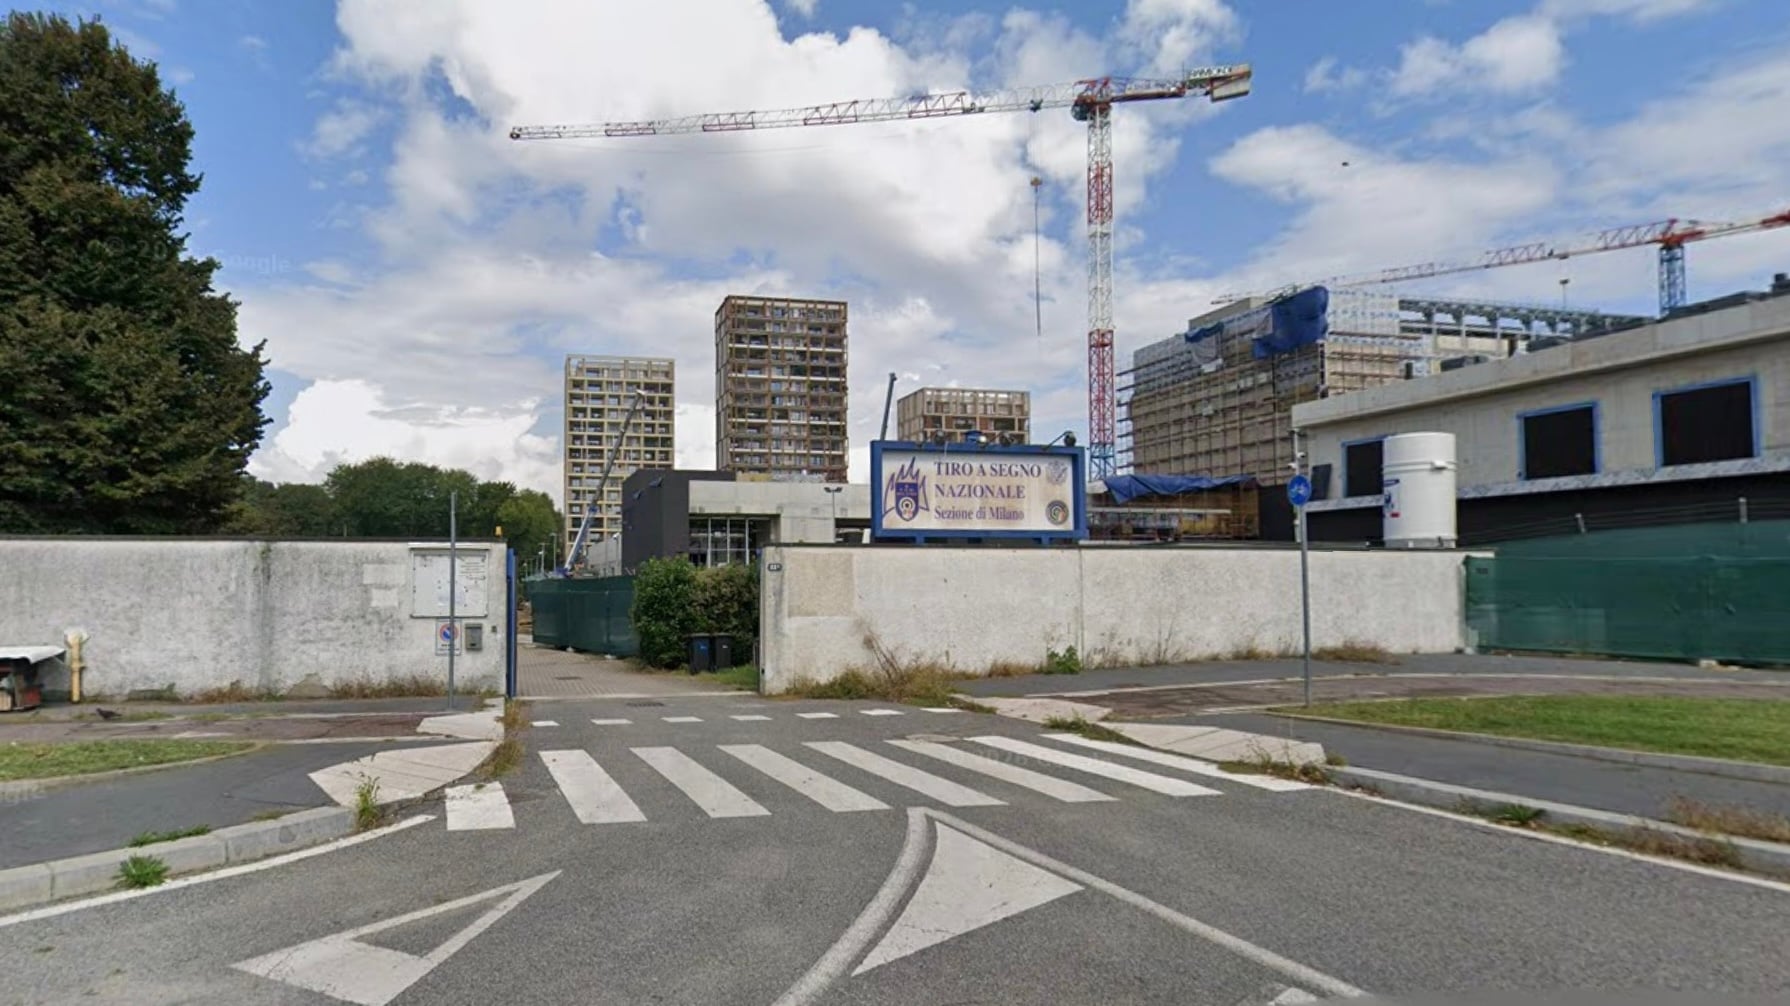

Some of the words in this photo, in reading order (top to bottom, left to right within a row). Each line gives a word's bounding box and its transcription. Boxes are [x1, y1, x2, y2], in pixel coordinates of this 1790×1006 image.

[934, 462, 973, 476] TIRO
[976, 464, 987, 476] A
[990, 463, 1042, 478] SEGNO
[934, 483, 1026, 499] NAZIONALE
[934, 505, 974, 520] Sezione
[976, 506, 986, 520] di
[989, 506, 1025, 521] Milano
